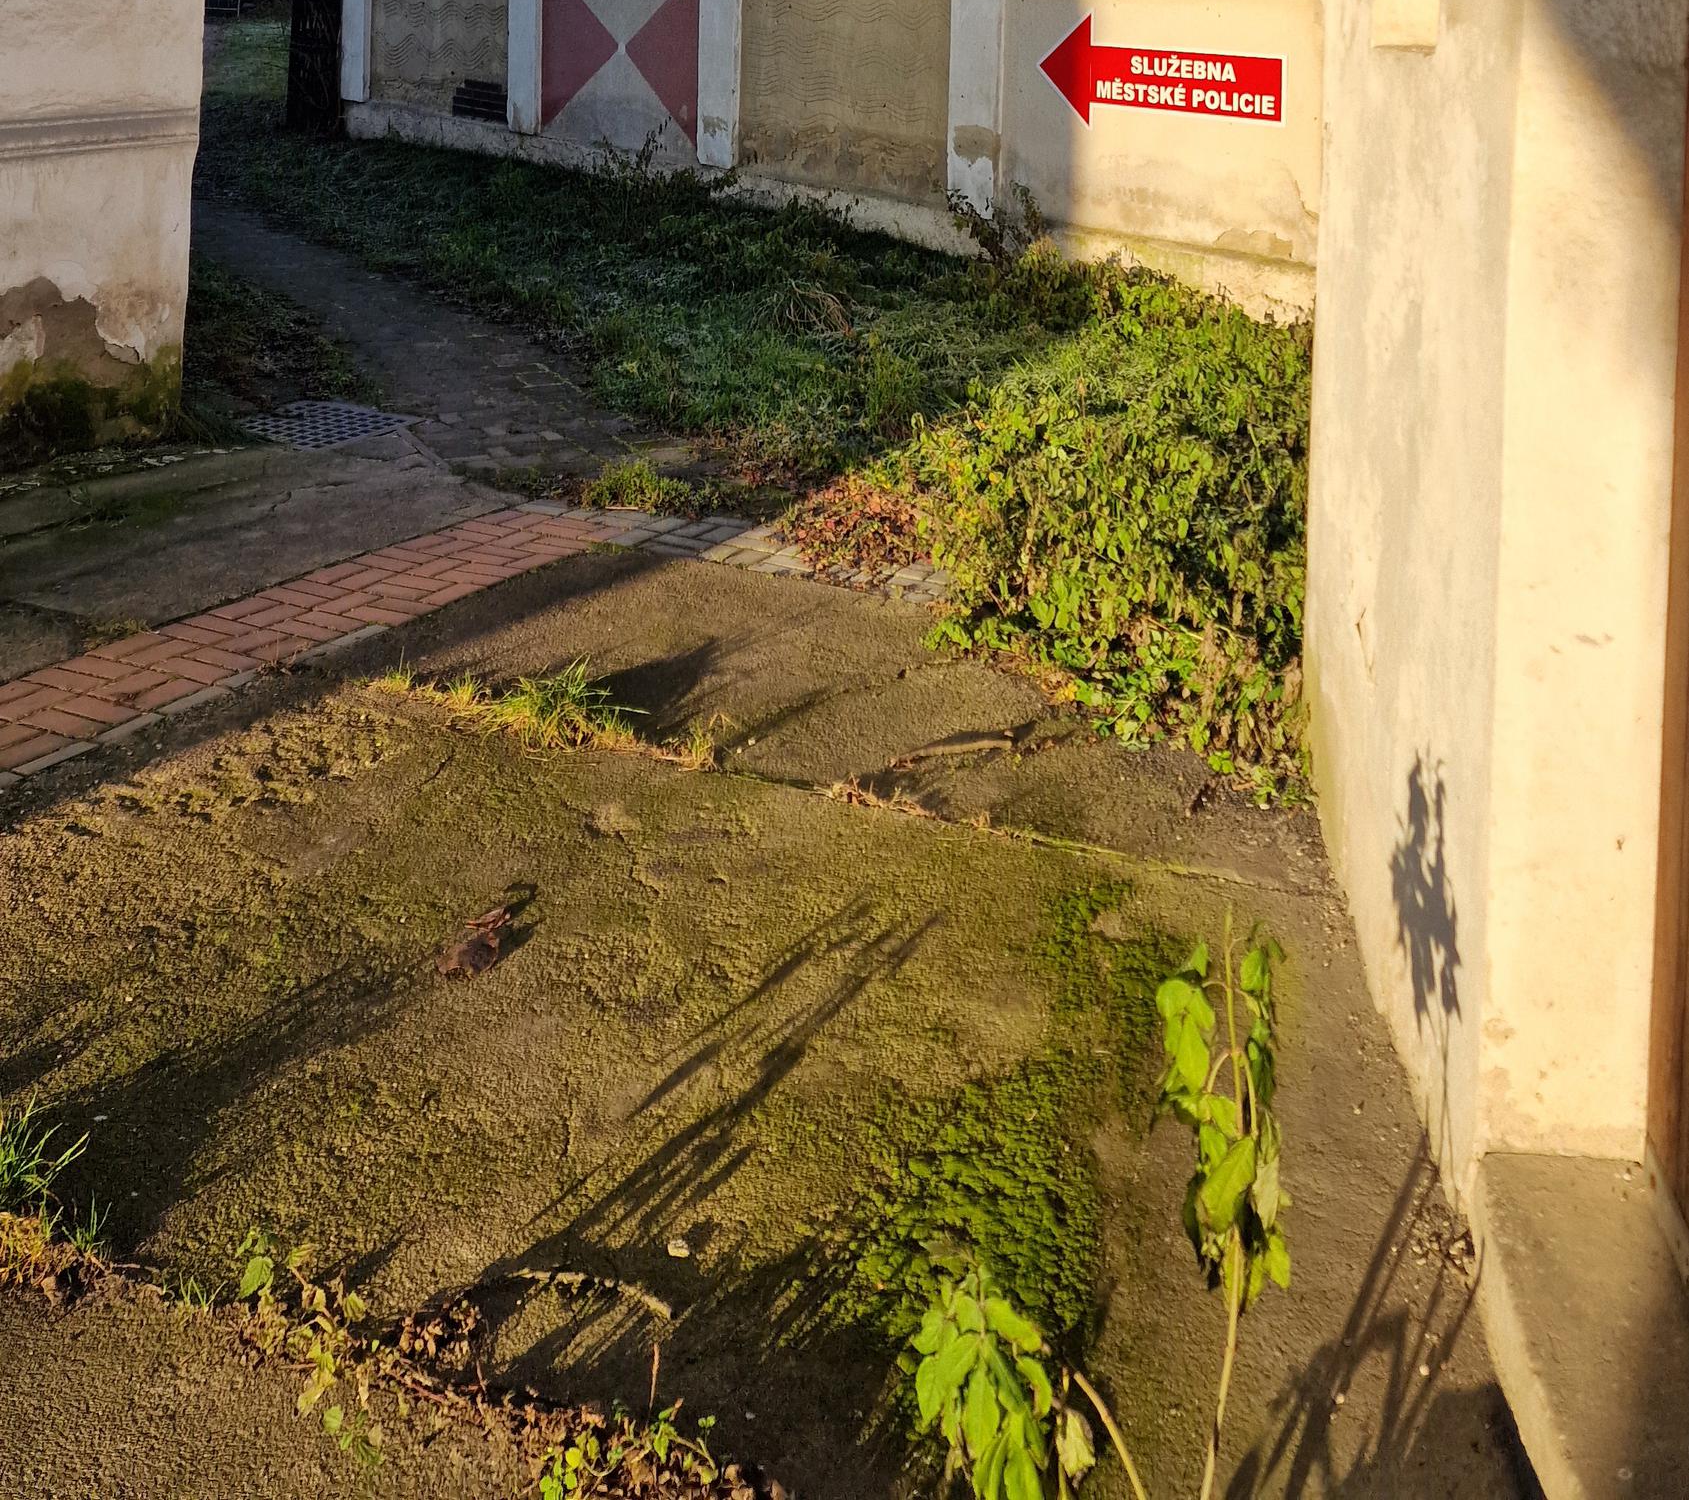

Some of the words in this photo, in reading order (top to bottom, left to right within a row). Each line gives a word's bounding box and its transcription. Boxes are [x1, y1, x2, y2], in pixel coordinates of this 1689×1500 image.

[1130, 55, 1237, 82] SLUŽEBNA
[1096, 78, 1186, 107] MĚSTSKÉ
[1191, 89, 1276, 116] POLICIE
